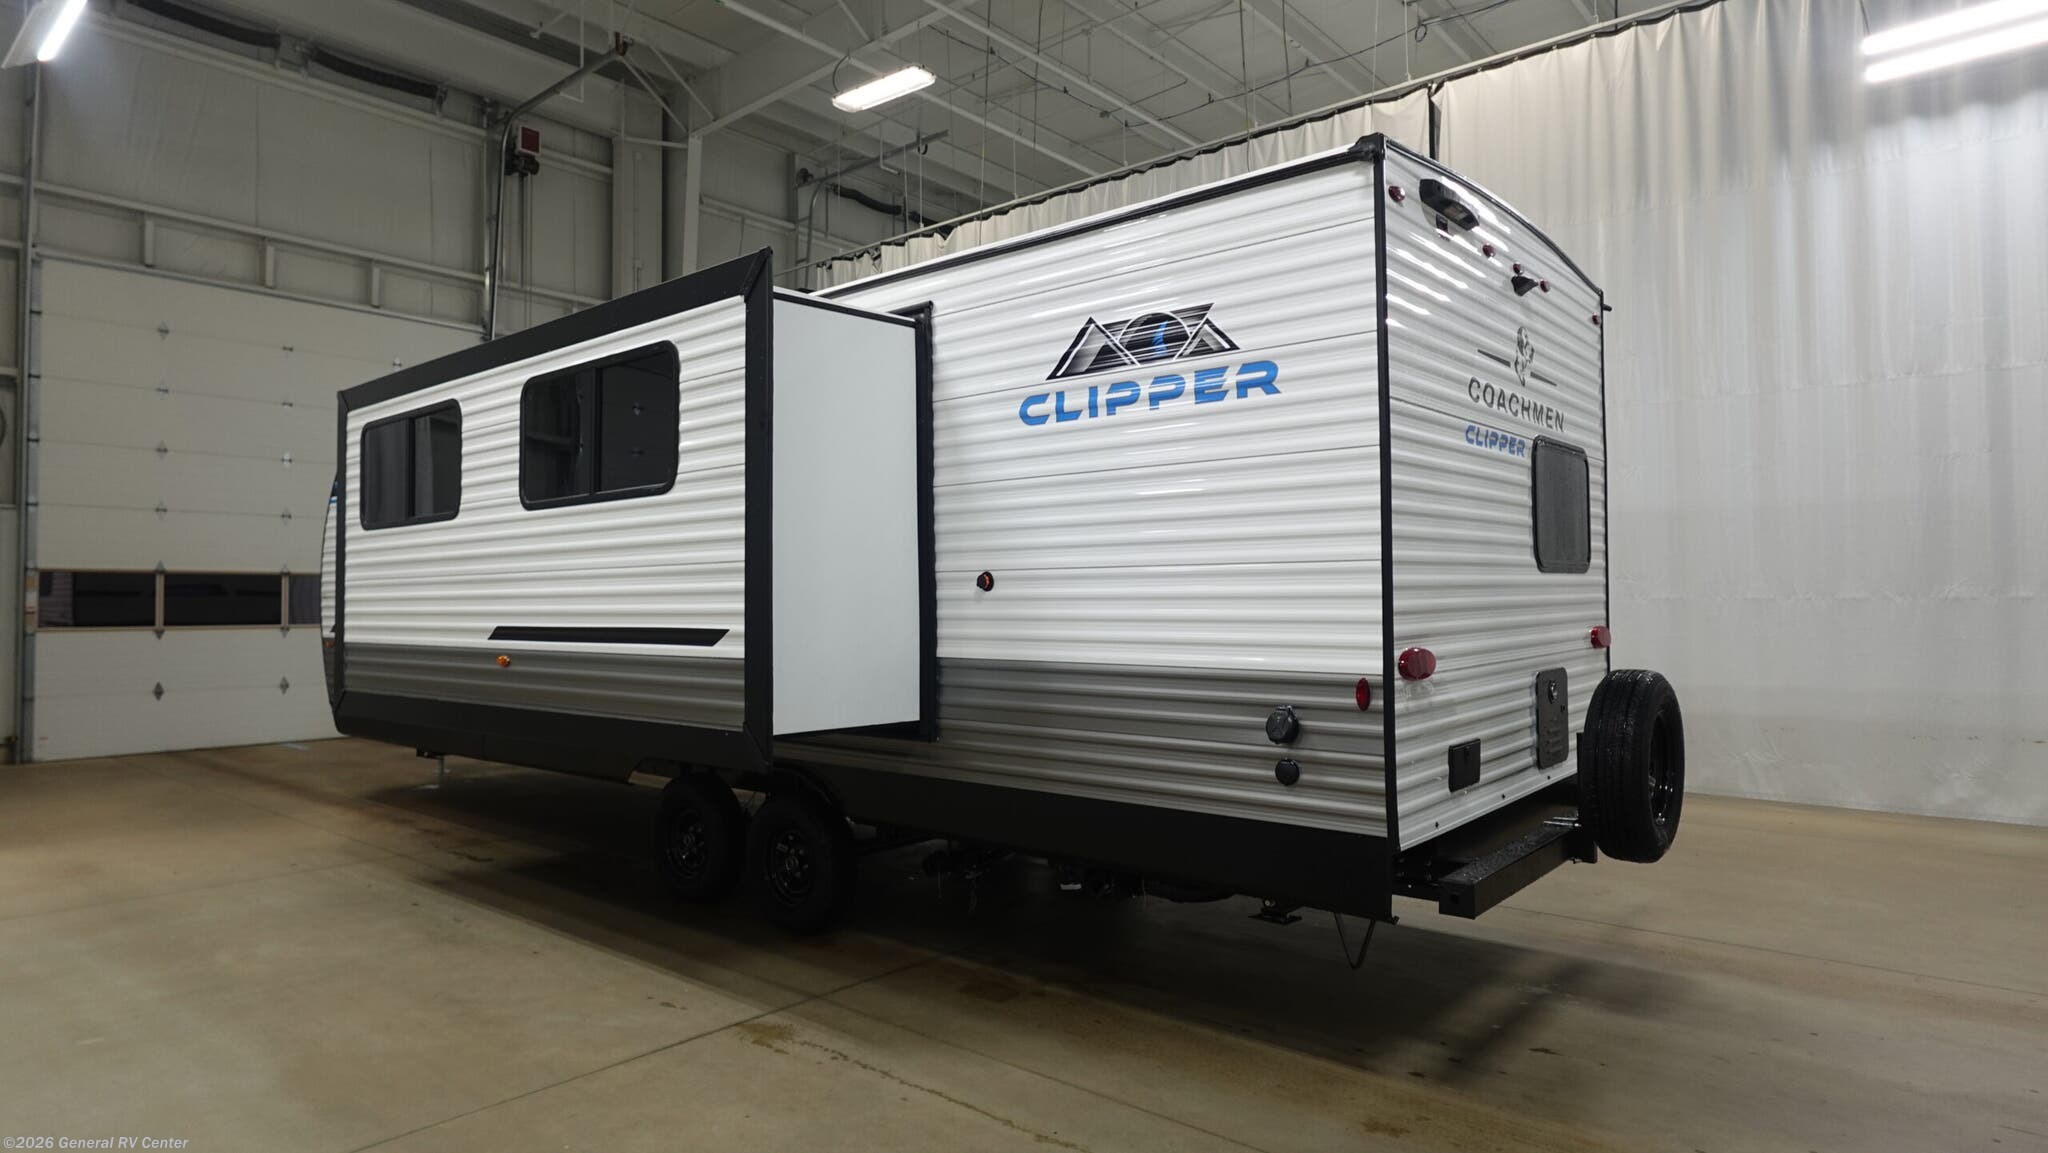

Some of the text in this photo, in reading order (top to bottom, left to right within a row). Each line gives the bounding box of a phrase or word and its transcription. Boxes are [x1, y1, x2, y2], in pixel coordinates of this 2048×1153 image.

[1019, 360, 1281, 426] CLIPPER
[1468, 376, 1565, 432] COACHMEN
[1465, 424, 1526, 457] CLIPPER
